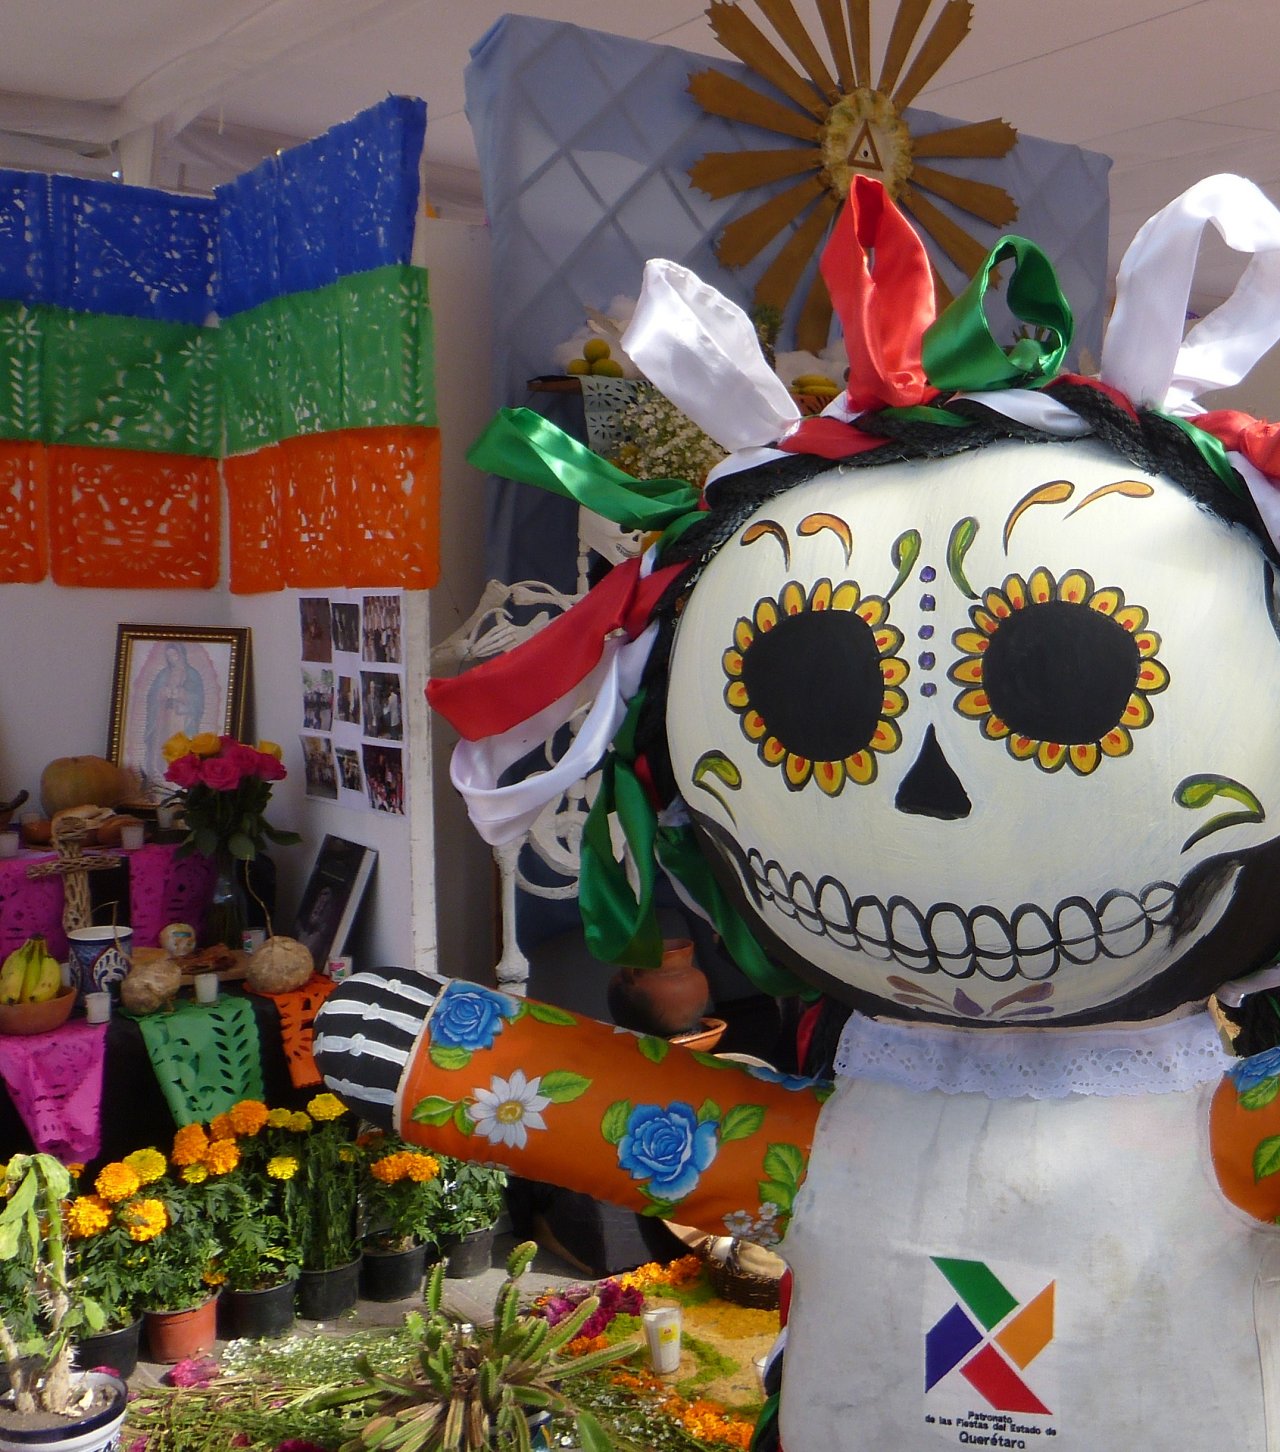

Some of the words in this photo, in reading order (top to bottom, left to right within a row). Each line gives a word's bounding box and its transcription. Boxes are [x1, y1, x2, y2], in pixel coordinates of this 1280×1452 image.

[925, 1415, 935, 1424] de
[939, 1416, 952, 1426] las
[956, 1418, 989, 1430] Fiestas
[993, 1422, 1006, 1431] del
[1010, 1424, 1041, 1435] Estado
[1045, 1427, 1057, 1436] de
[968, 1411, 1012, 1424] Patronato
[959, 1430, 1025, 1449] Querétaro
